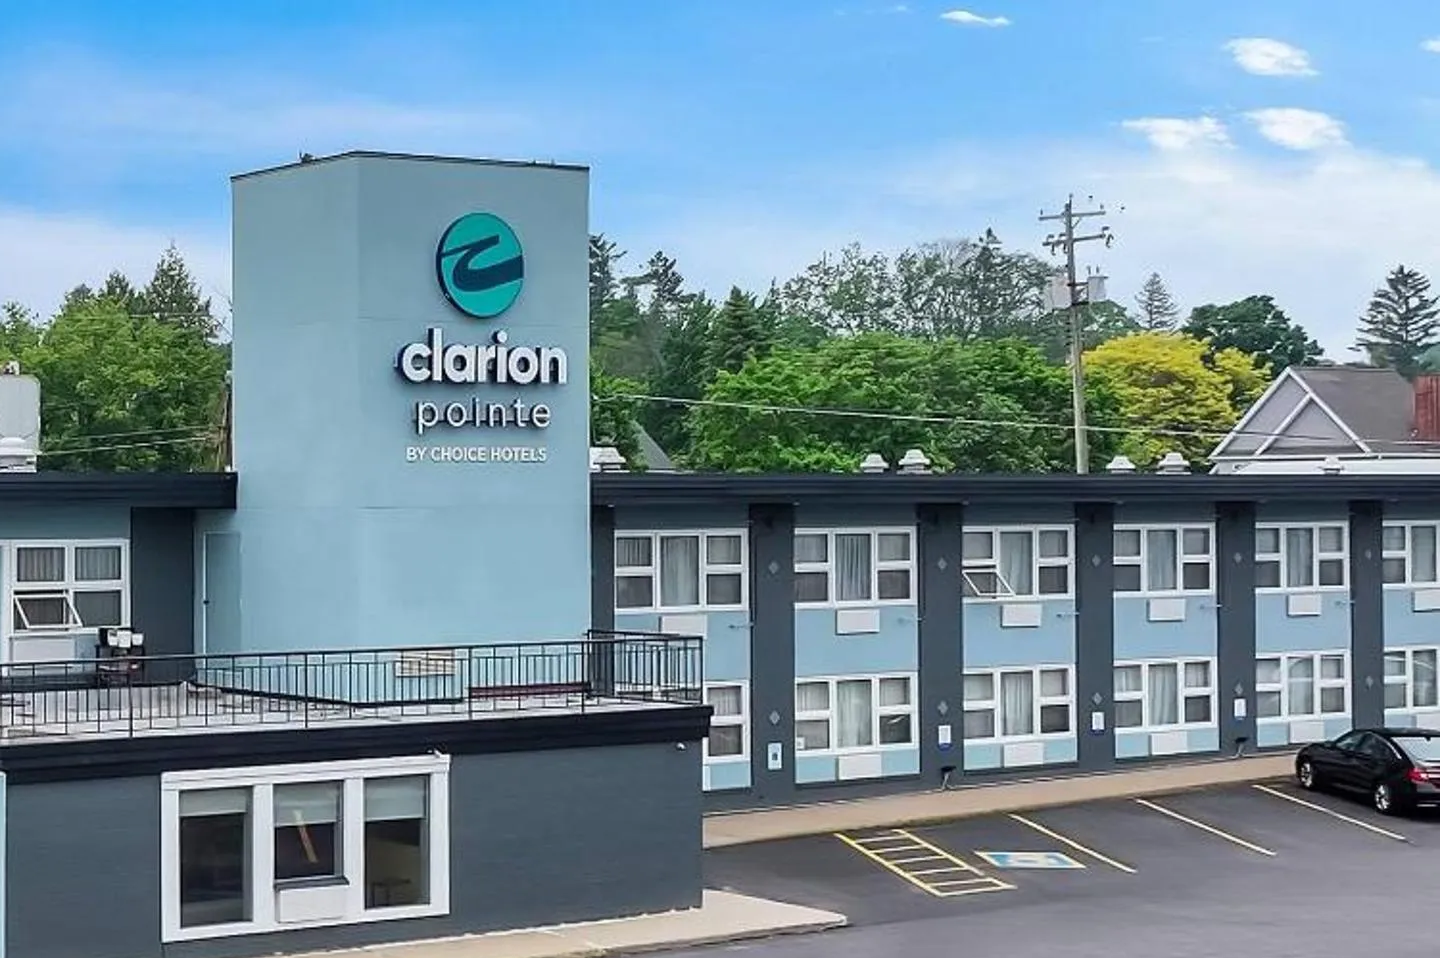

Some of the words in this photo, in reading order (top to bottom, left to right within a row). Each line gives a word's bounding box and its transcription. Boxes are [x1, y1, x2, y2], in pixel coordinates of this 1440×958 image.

[398, 327, 568, 384] clarion
[415, 397, 551, 435] pointe
[406, 446, 427, 461] BY
[430, 446, 487, 462] CHOICE
[490, 446, 547, 462] HOTELS
